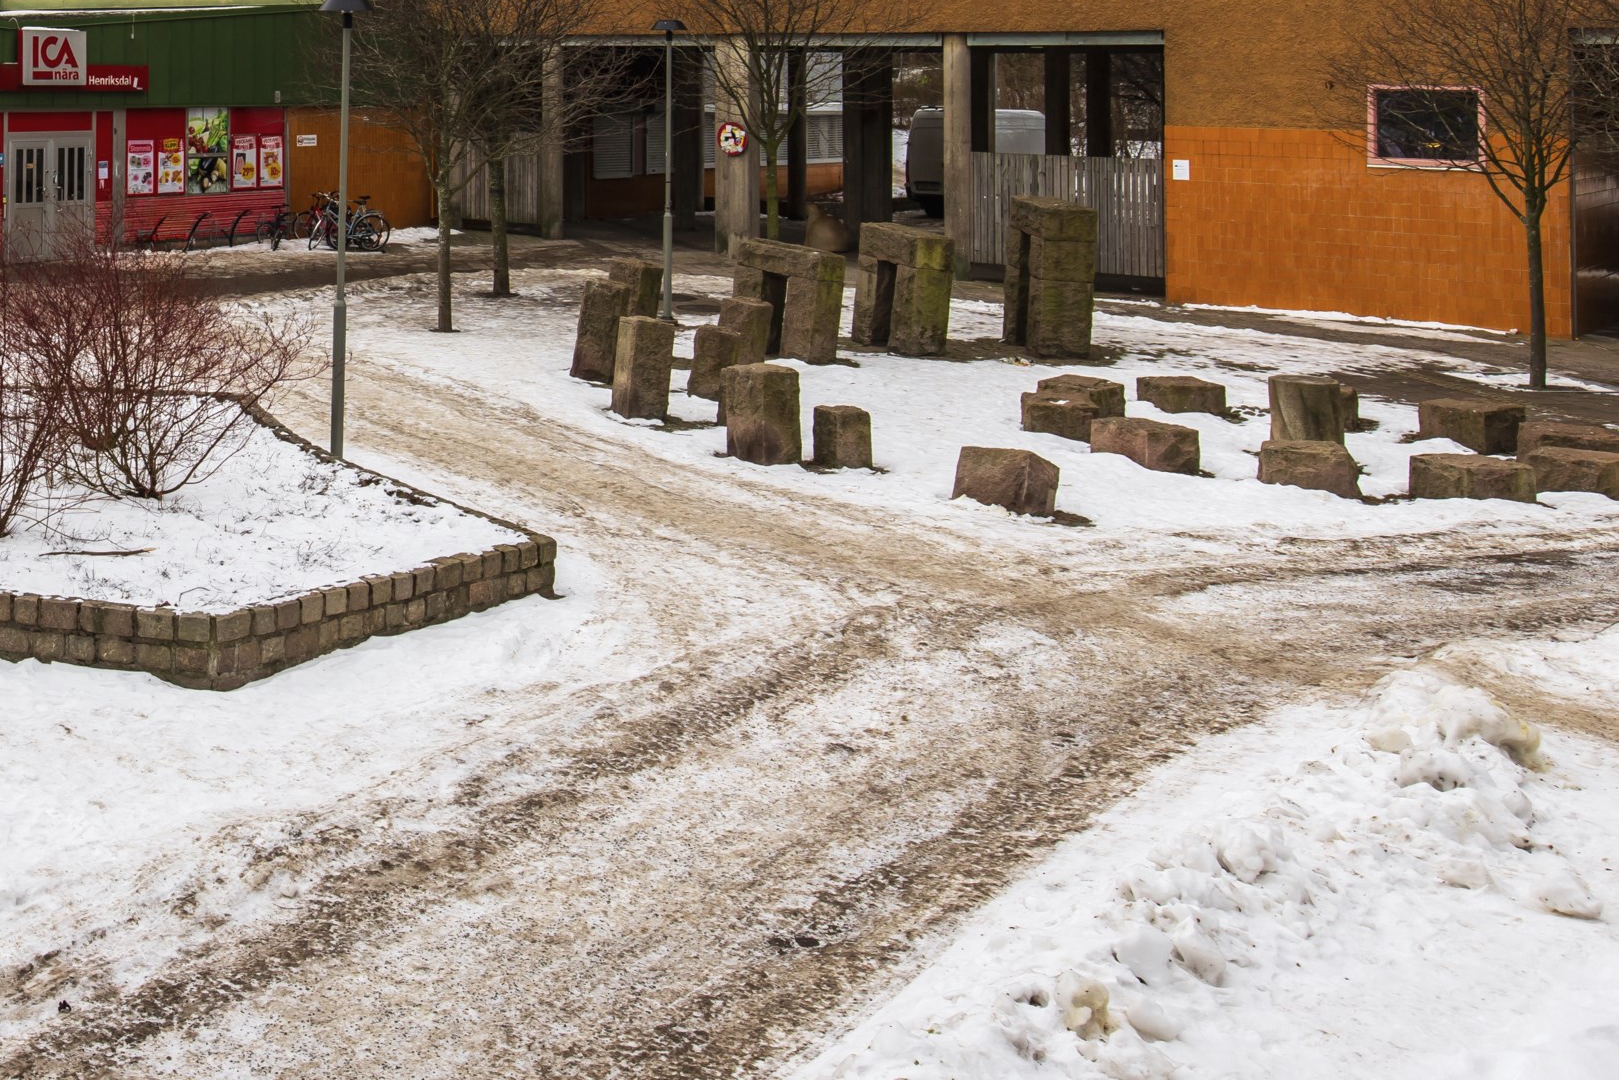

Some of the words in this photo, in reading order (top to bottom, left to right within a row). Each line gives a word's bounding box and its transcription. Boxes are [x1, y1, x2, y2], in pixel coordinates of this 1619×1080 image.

[32, 36, 79, 68] ICA
[53, 68, 79, 80] nära
[89, 75, 132, 86] Henriksdal
